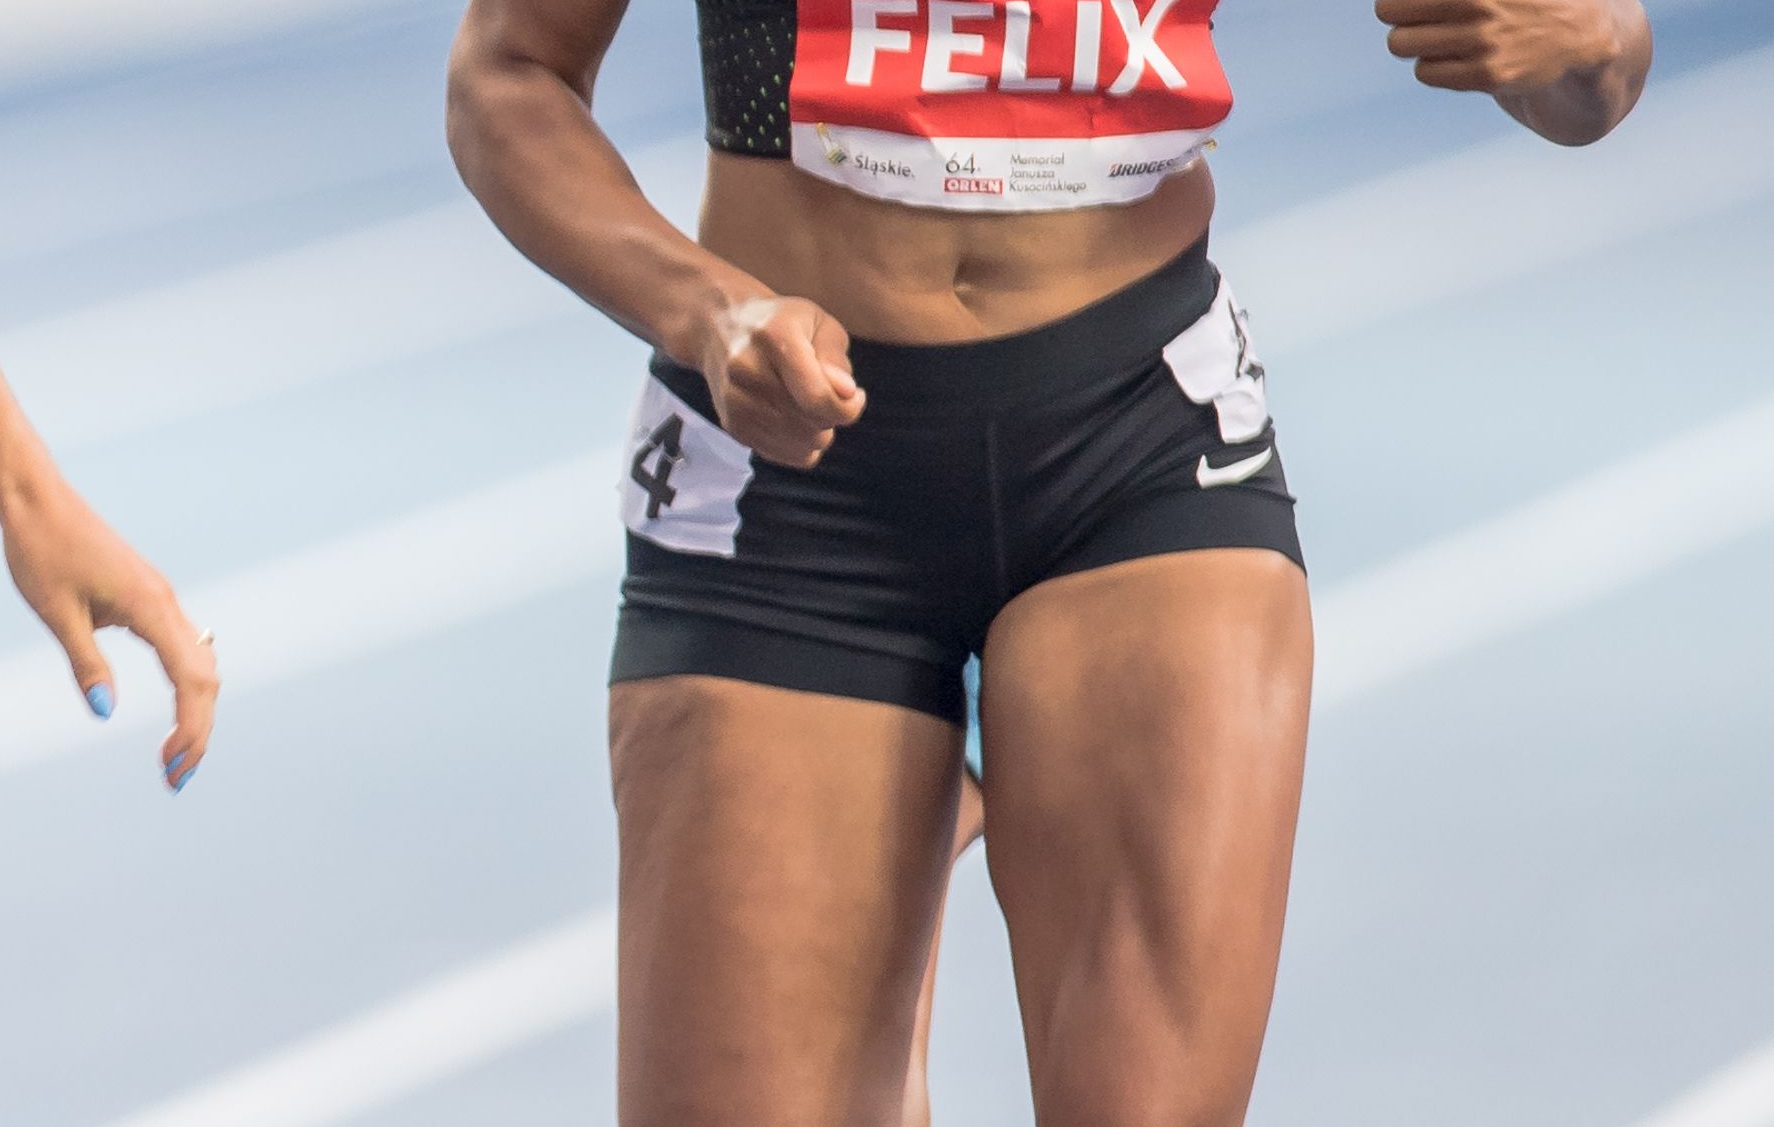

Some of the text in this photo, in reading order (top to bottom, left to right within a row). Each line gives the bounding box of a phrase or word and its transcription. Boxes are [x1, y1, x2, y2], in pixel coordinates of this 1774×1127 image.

[1009, 166, 1055, 179] Janusza
[946, 179, 1001, 193] ORLEN
[631, 412, 683, 519] 4
